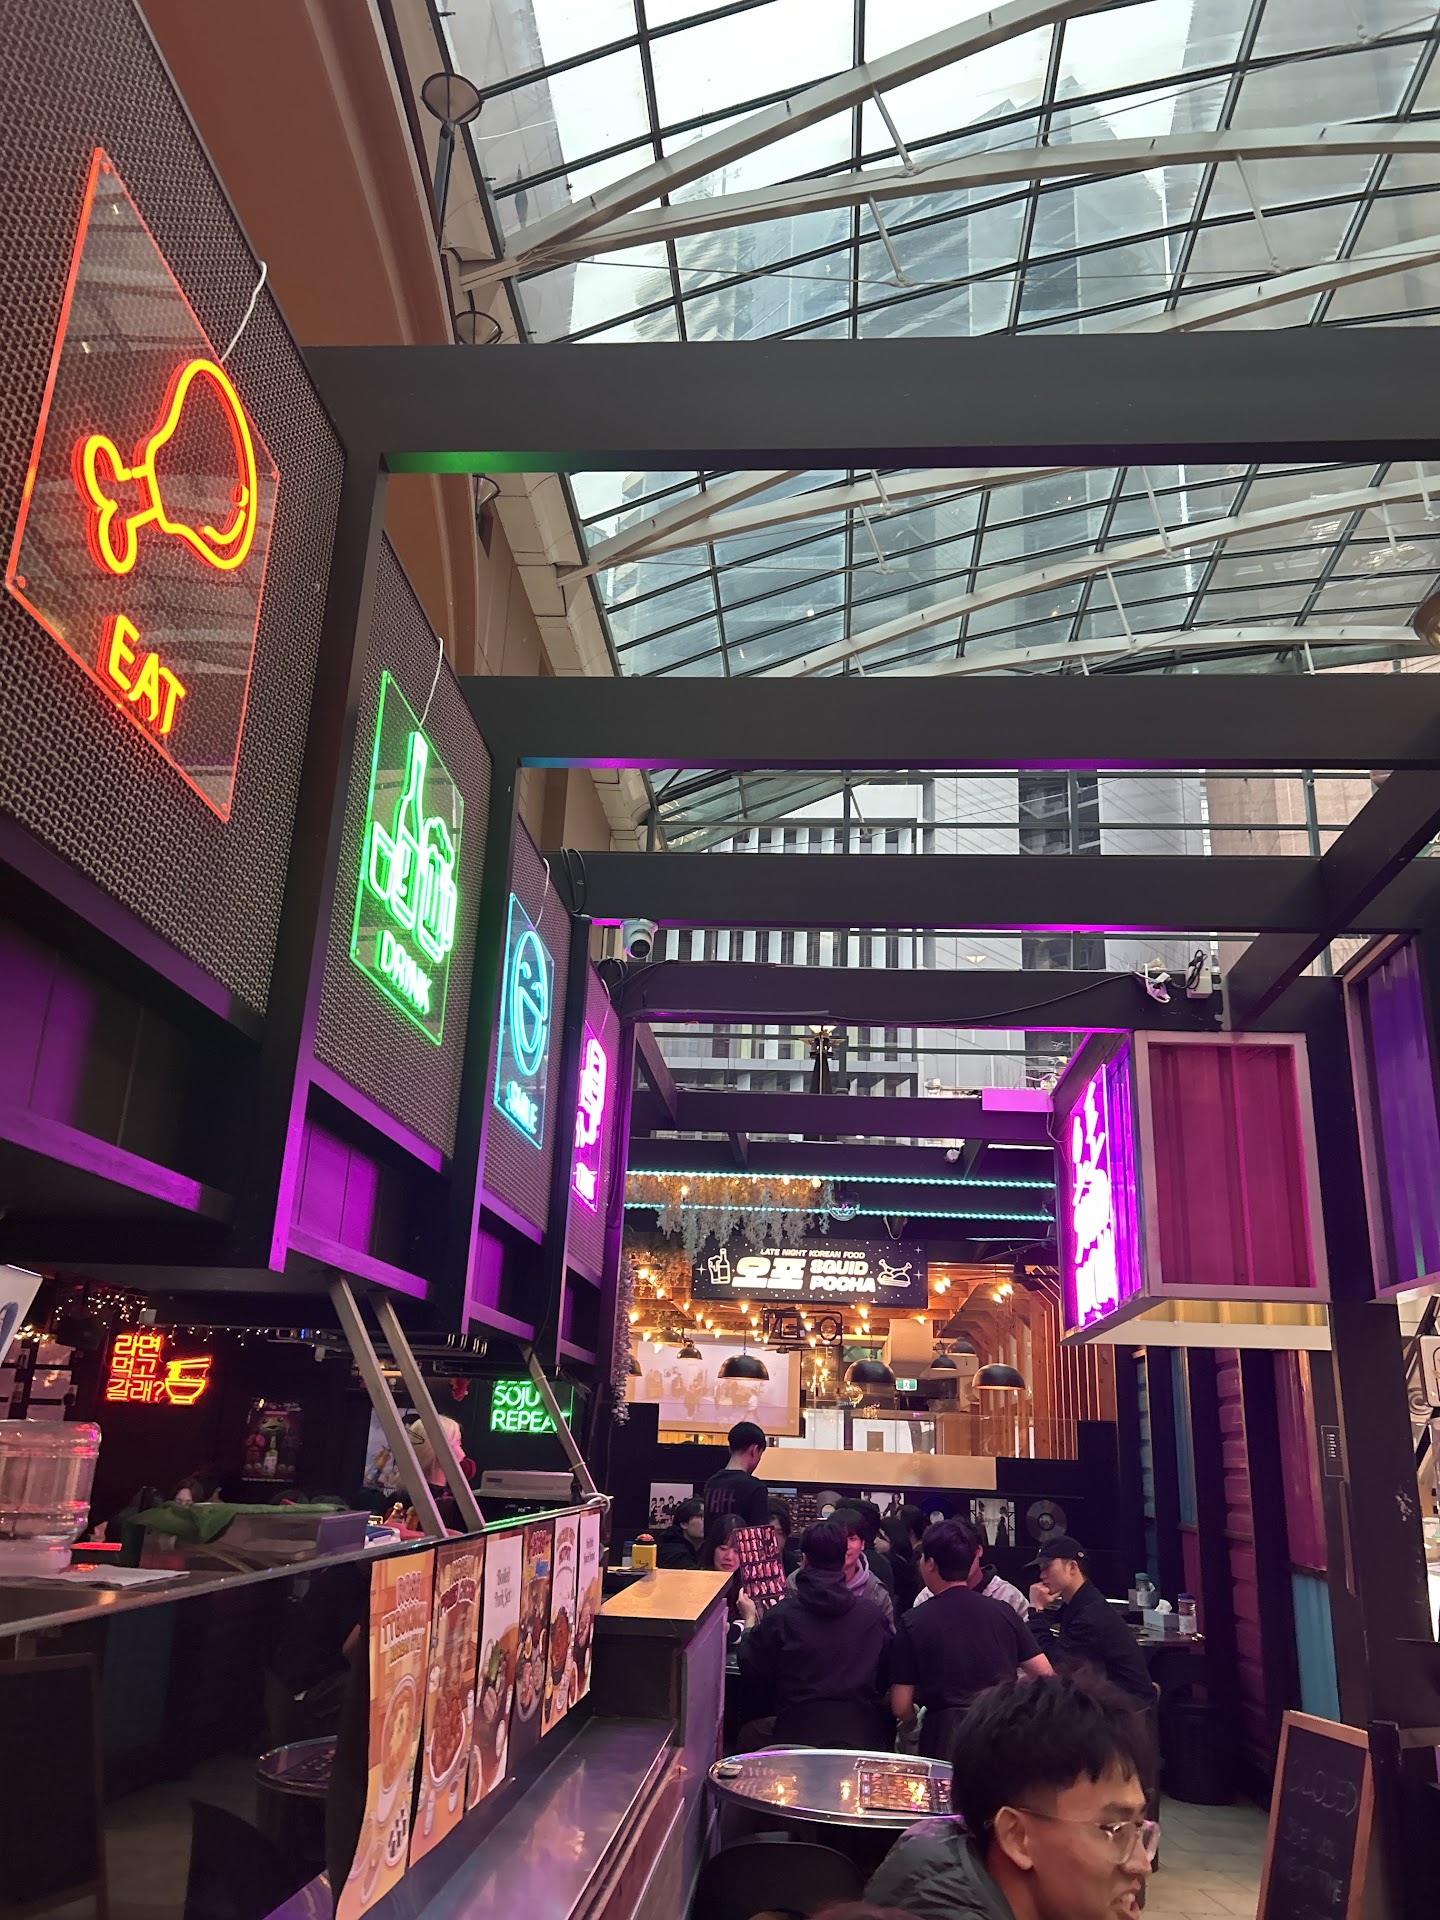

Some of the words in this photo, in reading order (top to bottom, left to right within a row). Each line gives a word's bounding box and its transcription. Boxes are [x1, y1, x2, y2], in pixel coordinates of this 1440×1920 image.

[99, 614, 187, 735] EAT
[376, 929, 433, 1015] DRINK
[760, 1248, 781, 1256] LATE
[782, 1249, 807, 1258] NIGHT
[808, 1250, 842, 1259] KOREAN
[843, 1251, 866, 1260] FOOD
[809, 1258, 869, 1276] SQUID
[114, 1333, 162, 1357] 라면
[111, 1356, 157, 1379] 먹고
[106, 1378, 166, 1402] 갈래?
[493, 1385, 541, 1411] SOJU
[705, 1487, 737, 1514] TAFF
